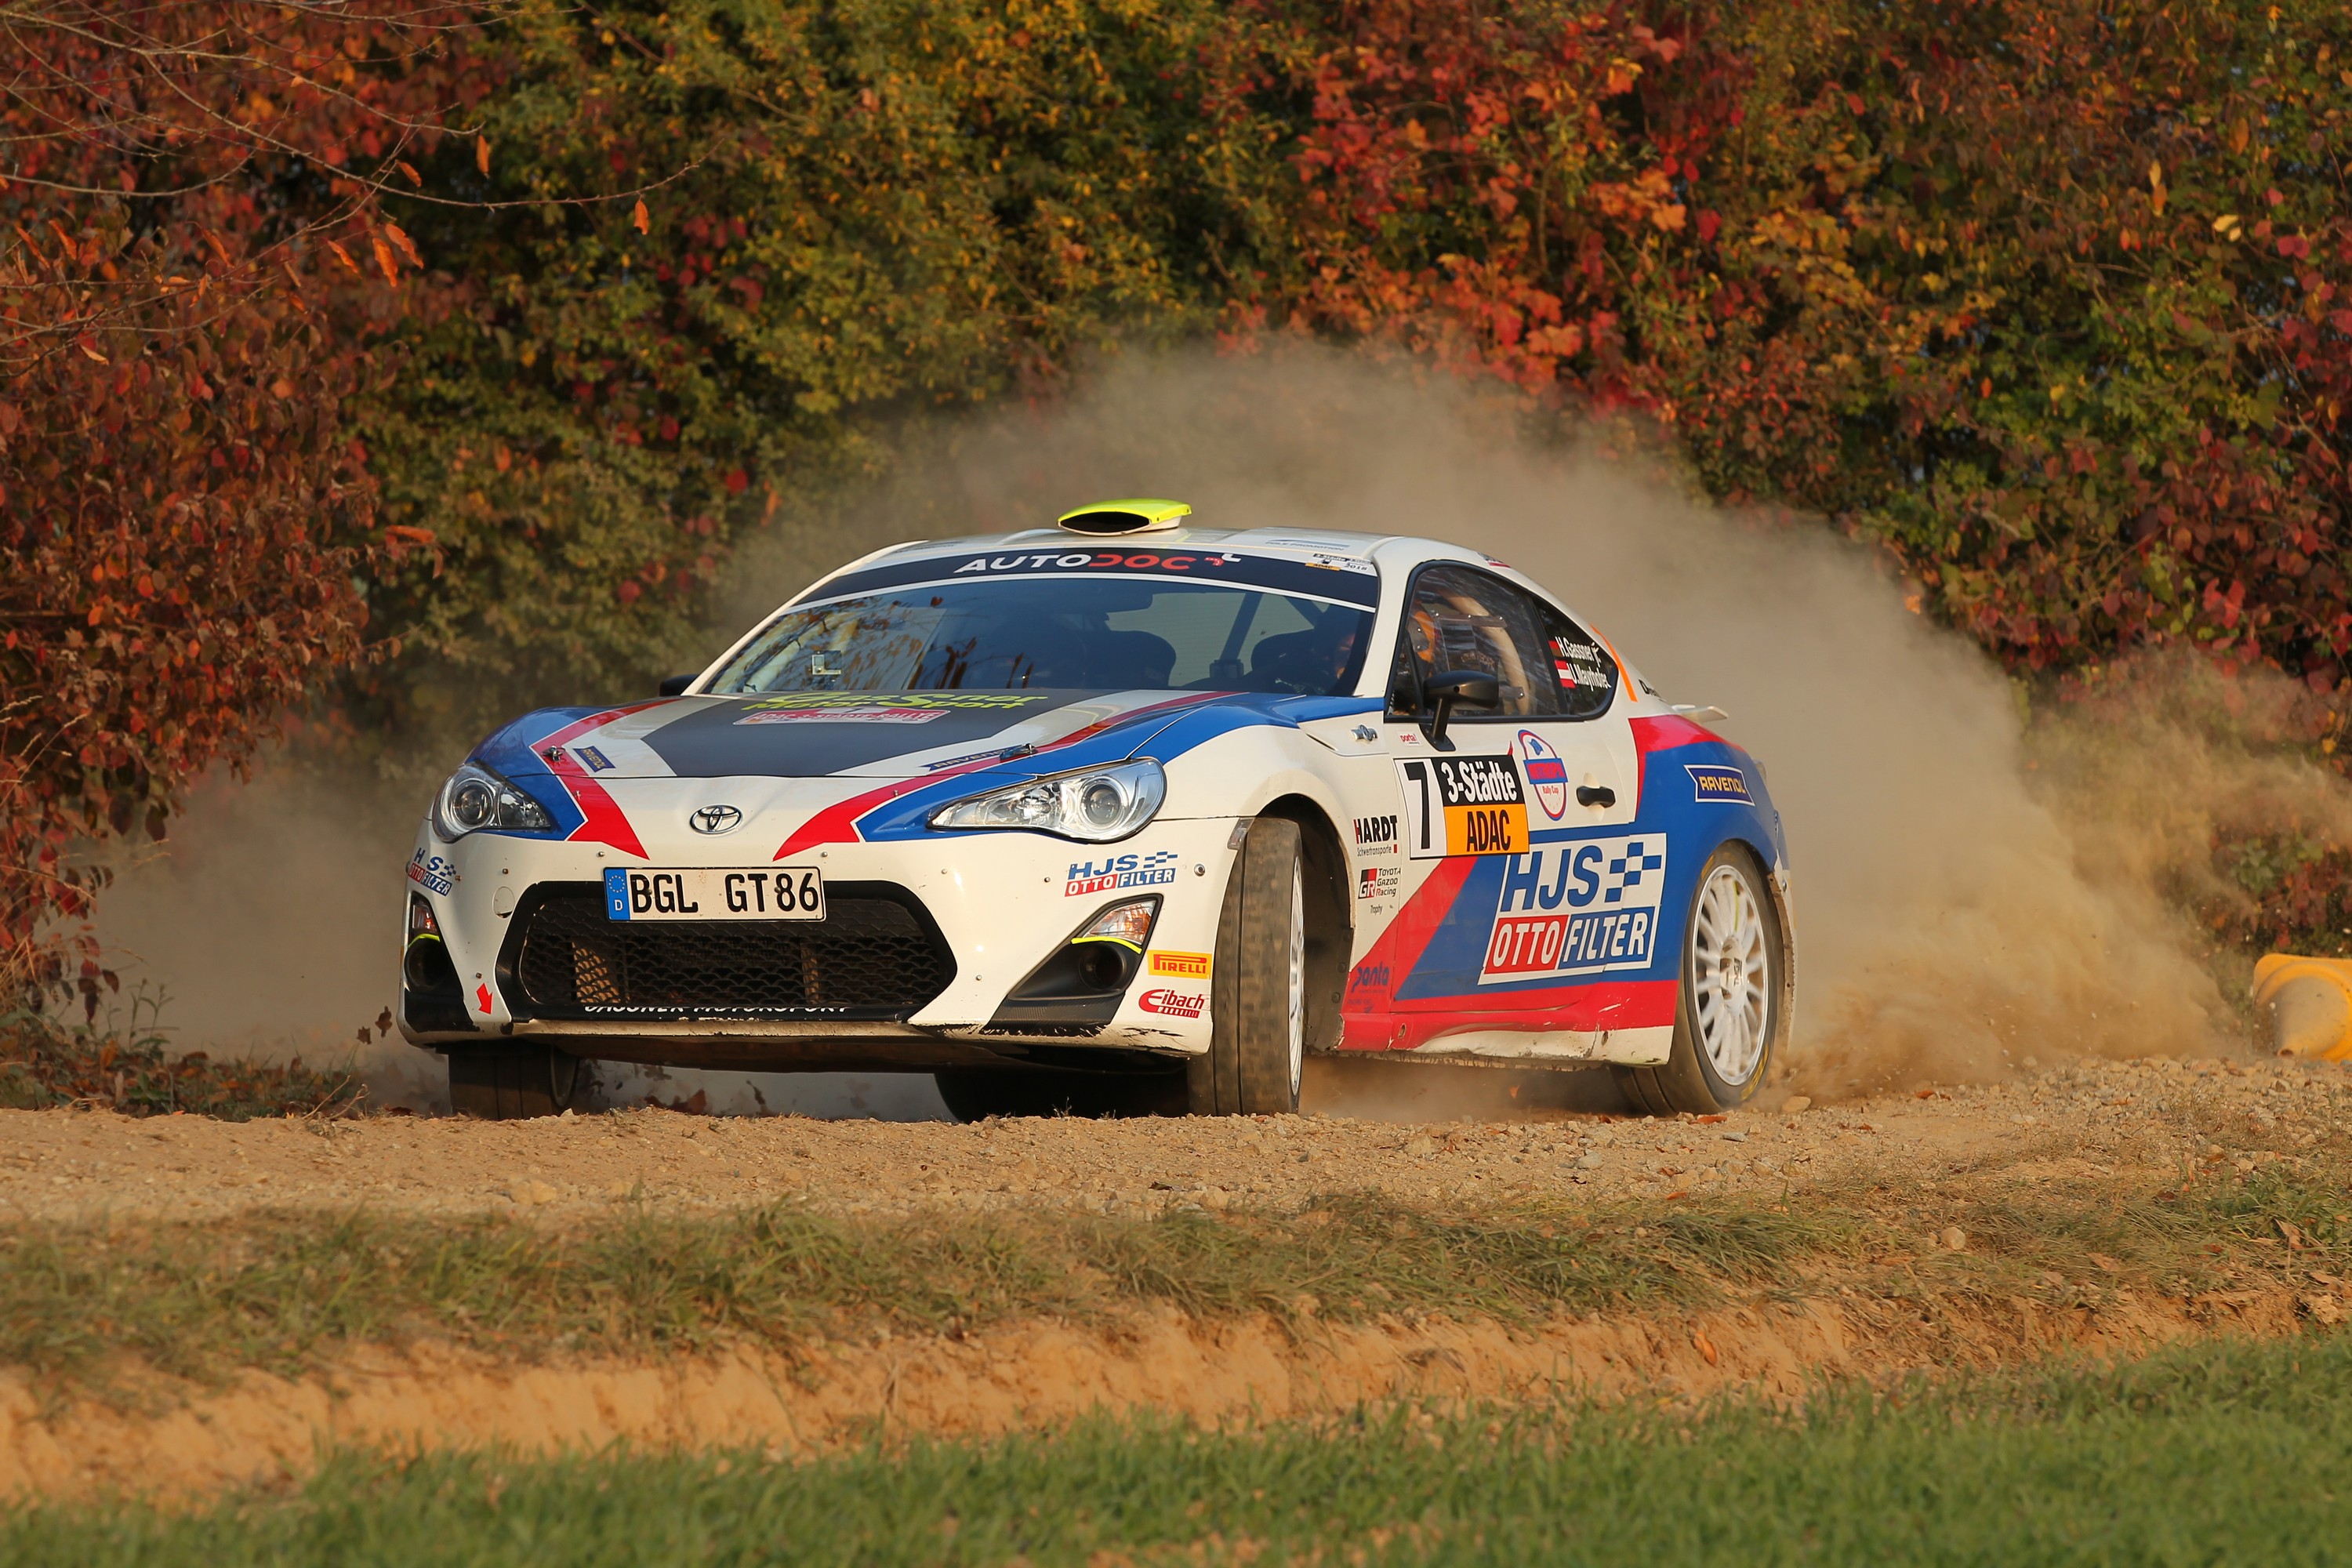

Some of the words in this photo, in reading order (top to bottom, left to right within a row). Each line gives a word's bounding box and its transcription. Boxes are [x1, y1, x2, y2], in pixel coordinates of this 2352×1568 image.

[953, 553, 1197, 574] AUTODOC
[1344, 562, 1368, 571] 2018
[1441, 760, 1518, 803] 3-Städte
[1698, 775, 1747, 794] RAVENOL
[1403, 761, 1431, 850] 7
[1353, 815, 1398, 845] HARDT
[1466, 809, 1512, 852] ADAC
[408, 864, 424, 881] OTTO
[422, 872, 451, 895] FILTER
[1068, 854, 1139, 880] HJS
[1501, 845, 1604, 913] HJS
[614, 899, 623, 911] D
[630, 873, 699, 913] BGL
[1068, 876, 1115, 895] OTTO
[1120, 869, 1173, 887] FILTER
[1359, 880, 1376, 898] GR
[1376, 887, 1396, 898] Racing
[1377, 877, 1399, 887] GAZOO
[1493, 920, 1560, 967] OTTO
[1563, 913, 1649, 963] FILTER
[1153, 953, 1207, 974] PIRELLI
[1138, 989, 1204, 1017] Eibach
